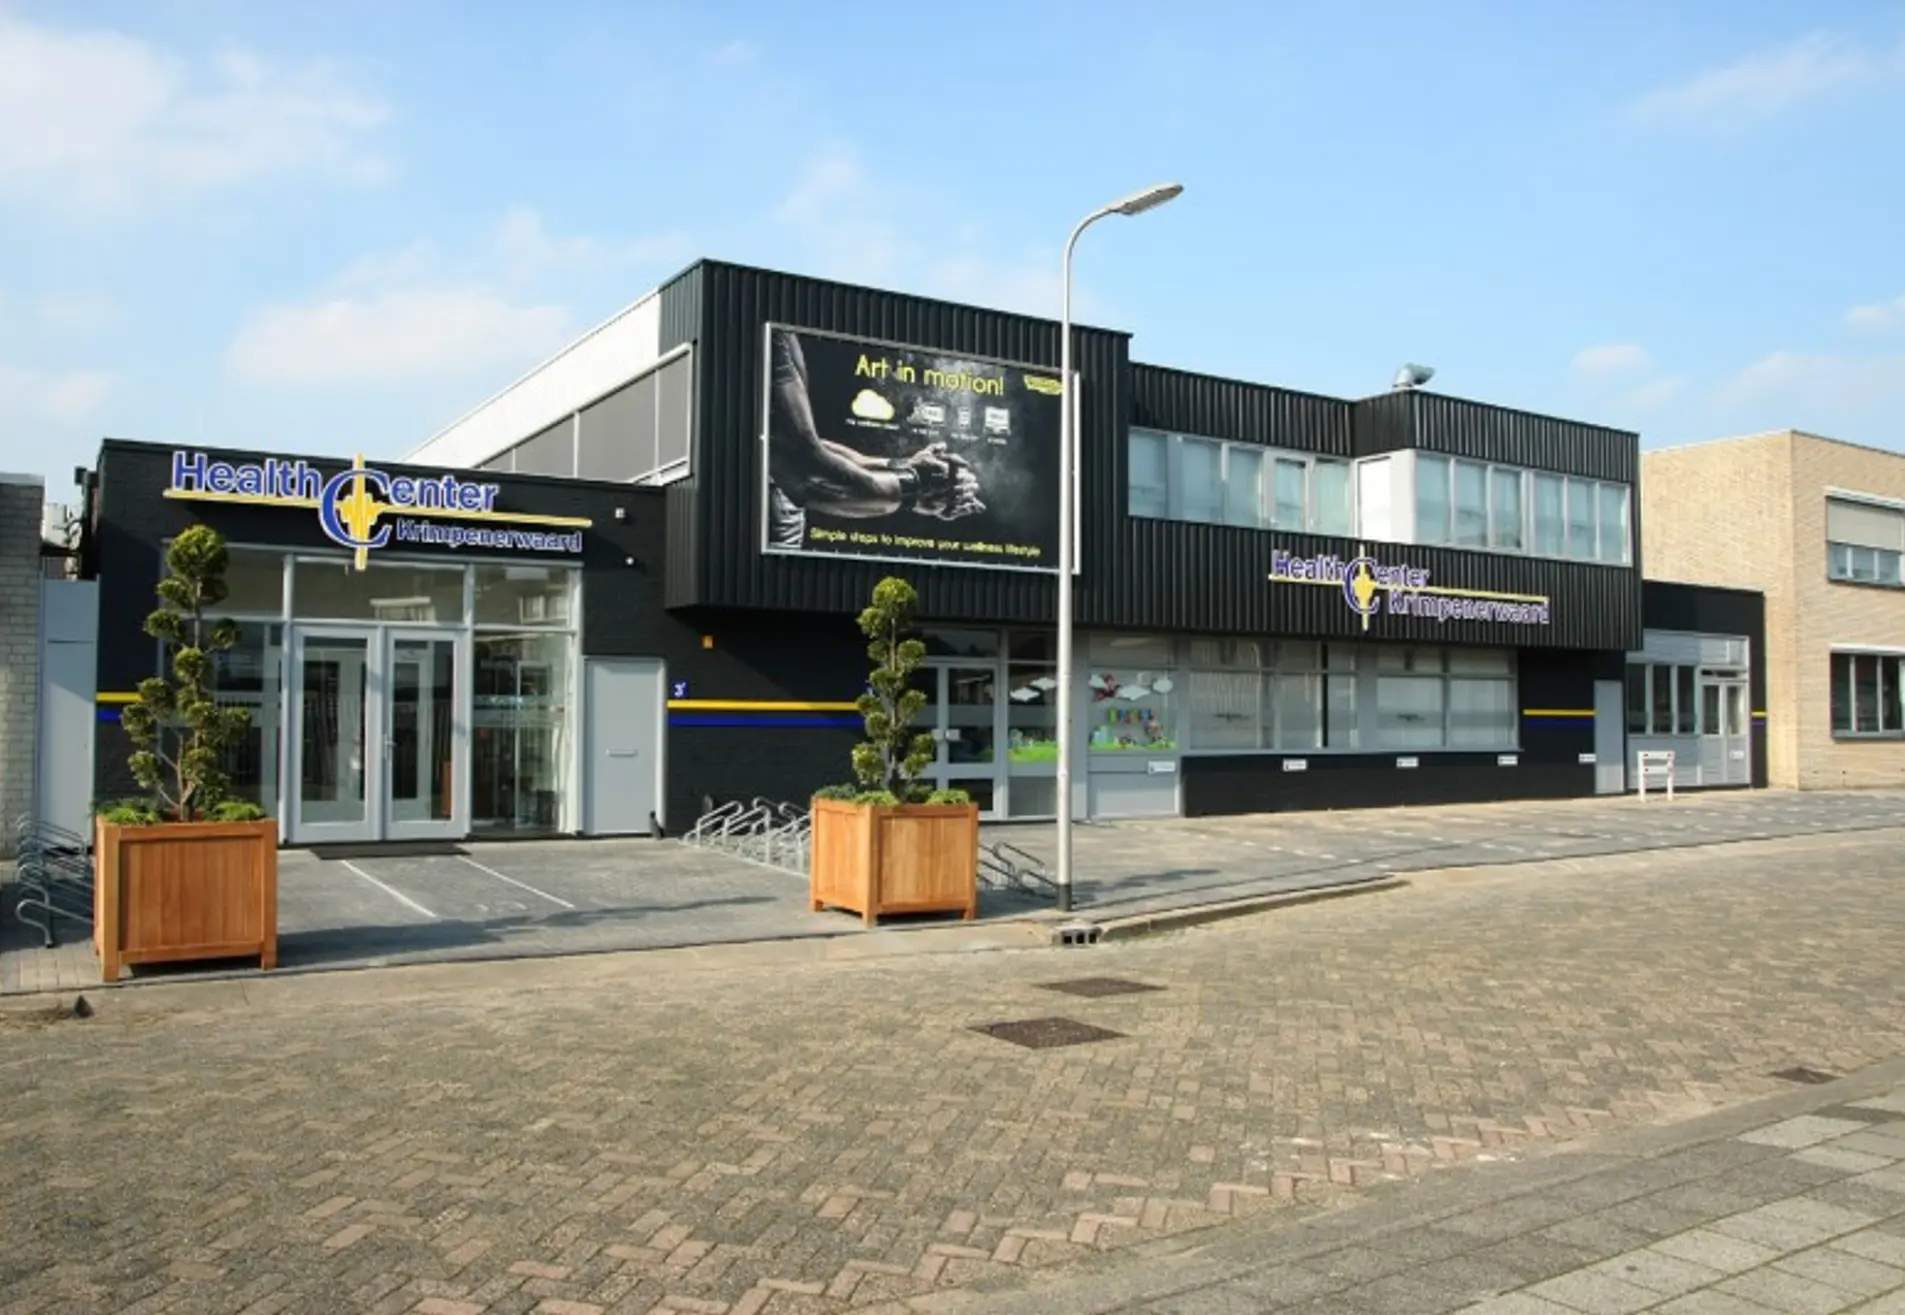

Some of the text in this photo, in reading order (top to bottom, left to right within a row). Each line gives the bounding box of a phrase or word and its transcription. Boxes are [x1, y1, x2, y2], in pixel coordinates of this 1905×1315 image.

[855, 354, 888, 378] Art
[897, 360, 915, 383] in
[923, 368, 1004, 396] motion!
[173, 450, 500, 549] Health Center
[396, 518, 583, 552] Krimpenerwaard
[1271, 549, 1430, 615] Health Center
[1388, 590, 1549, 624] Krimpenerwaard
